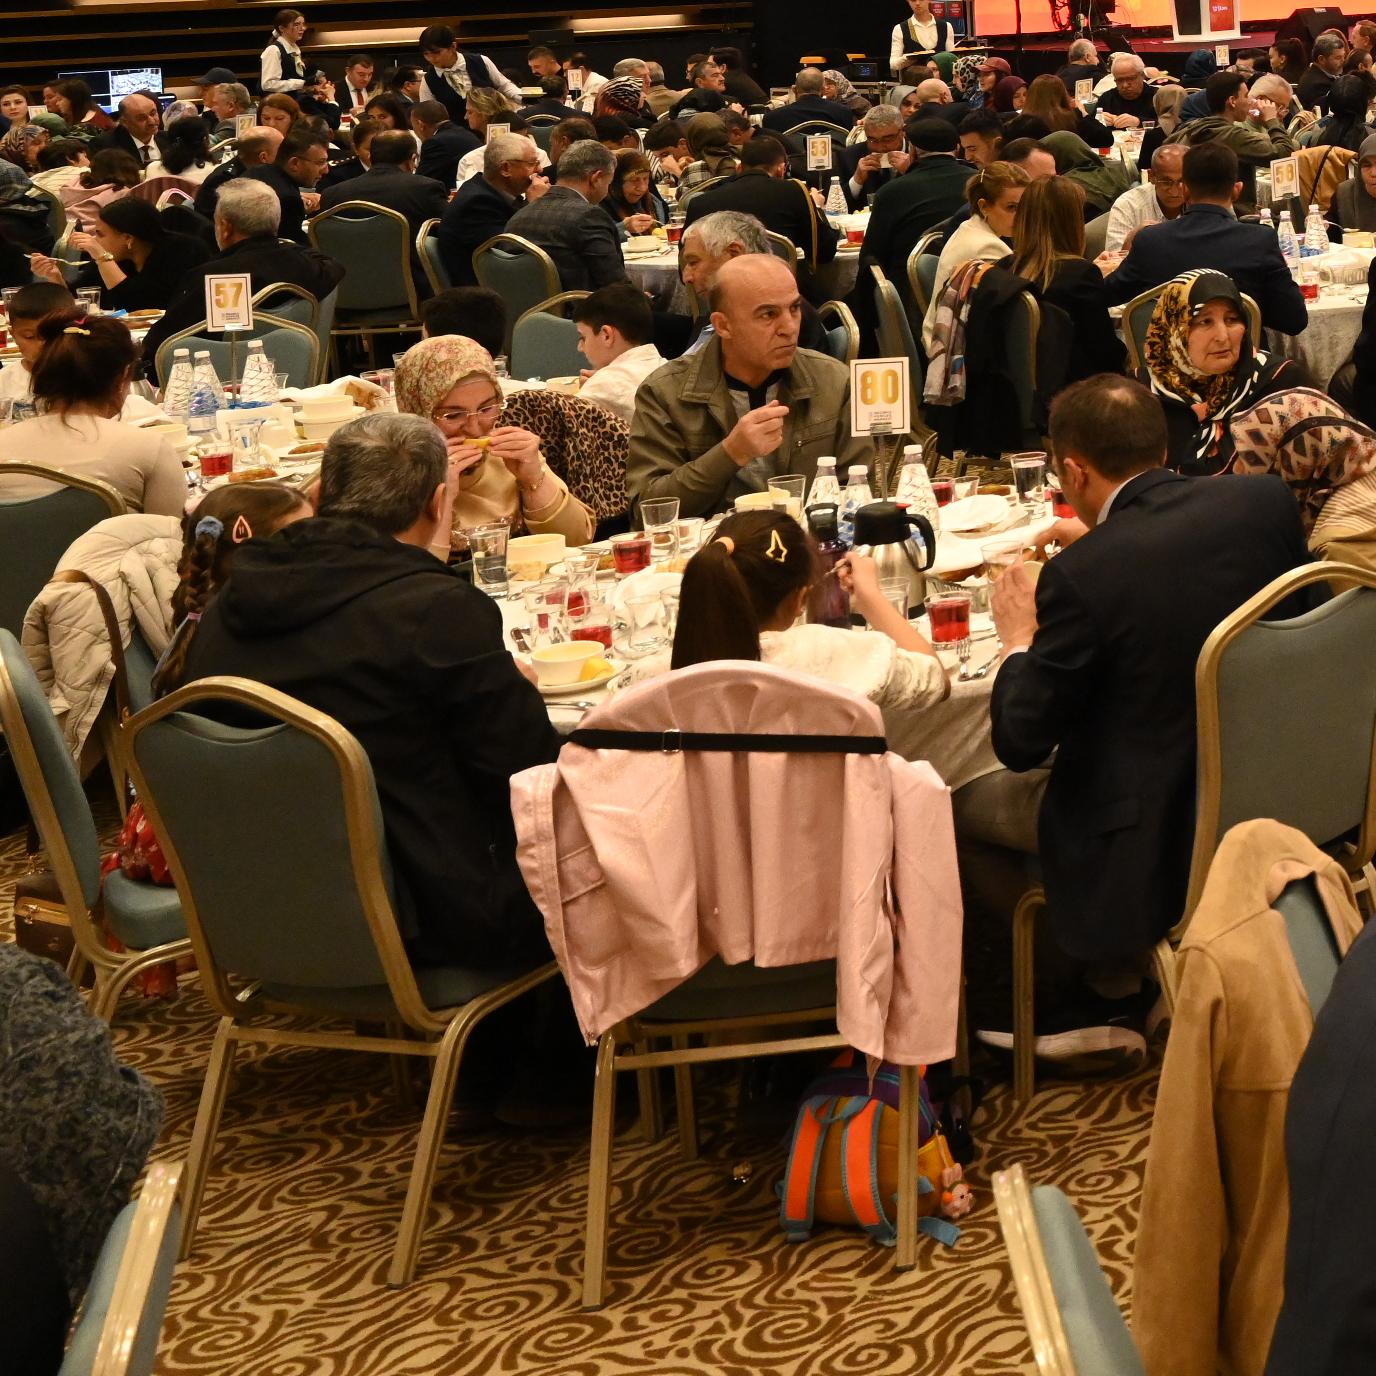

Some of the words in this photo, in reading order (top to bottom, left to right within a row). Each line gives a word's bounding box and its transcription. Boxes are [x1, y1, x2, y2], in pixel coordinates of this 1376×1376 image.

[811, 140, 827, 156] 53
[215, 281, 243, 309] 57
[860, 369, 899, 405] 80
